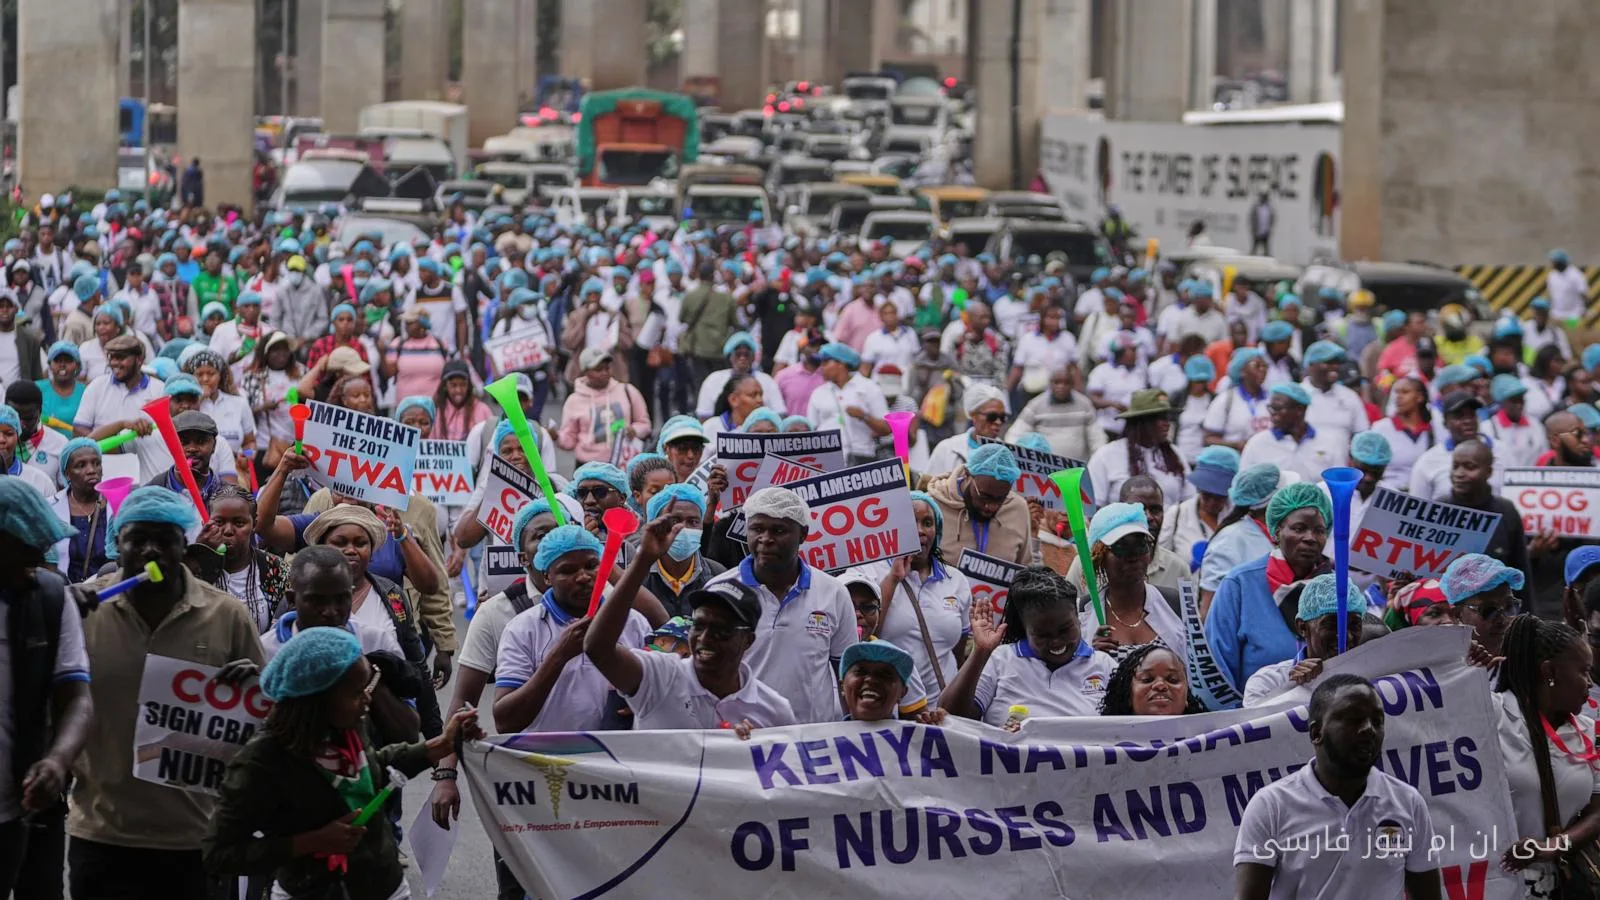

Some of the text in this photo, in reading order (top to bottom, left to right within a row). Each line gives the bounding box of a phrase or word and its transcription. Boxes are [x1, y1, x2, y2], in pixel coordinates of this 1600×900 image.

[308, 402, 418, 447] IMPLEMENT
[332, 431, 390, 459] THE 2017
[420, 442, 467, 457] LEMENT
[718, 433, 841, 454] PUNDA AMECHOKA
[433, 459, 453, 470] 2017
[490, 461, 528, 491] PUNDA
[333, 482, 355, 497] NOW
[412, 473, 473, 494] TWA
[821, 463, 905, 497] AMECHOKA
[1373, 490, 1497, 533] IMPLEMENT
[1519, 489, 1589, 512] COG
[1397, 521, 1460, 546] THE 2017
[1522, 513, 1592, 534] CT NOW
[845, 528, 899, 563] NOW
[960, 554, 1006, 579] PUNDA
[1182, 586, 1240, 706] IMPLEMENT
[172, 669, 273, 719] COG
[145, 701, 203, 735] SIGN
[750, 725, 959, 790] KENYA
[494, 780, 639, 805] KN UNM
[527, 822, 571, 832] Protection
[574, 821, 581, 830] &
[731, 816, 810, 871] OF
[833, 800, 1076, 869] NURSES
[1093, 781, 1207, 843] AND
